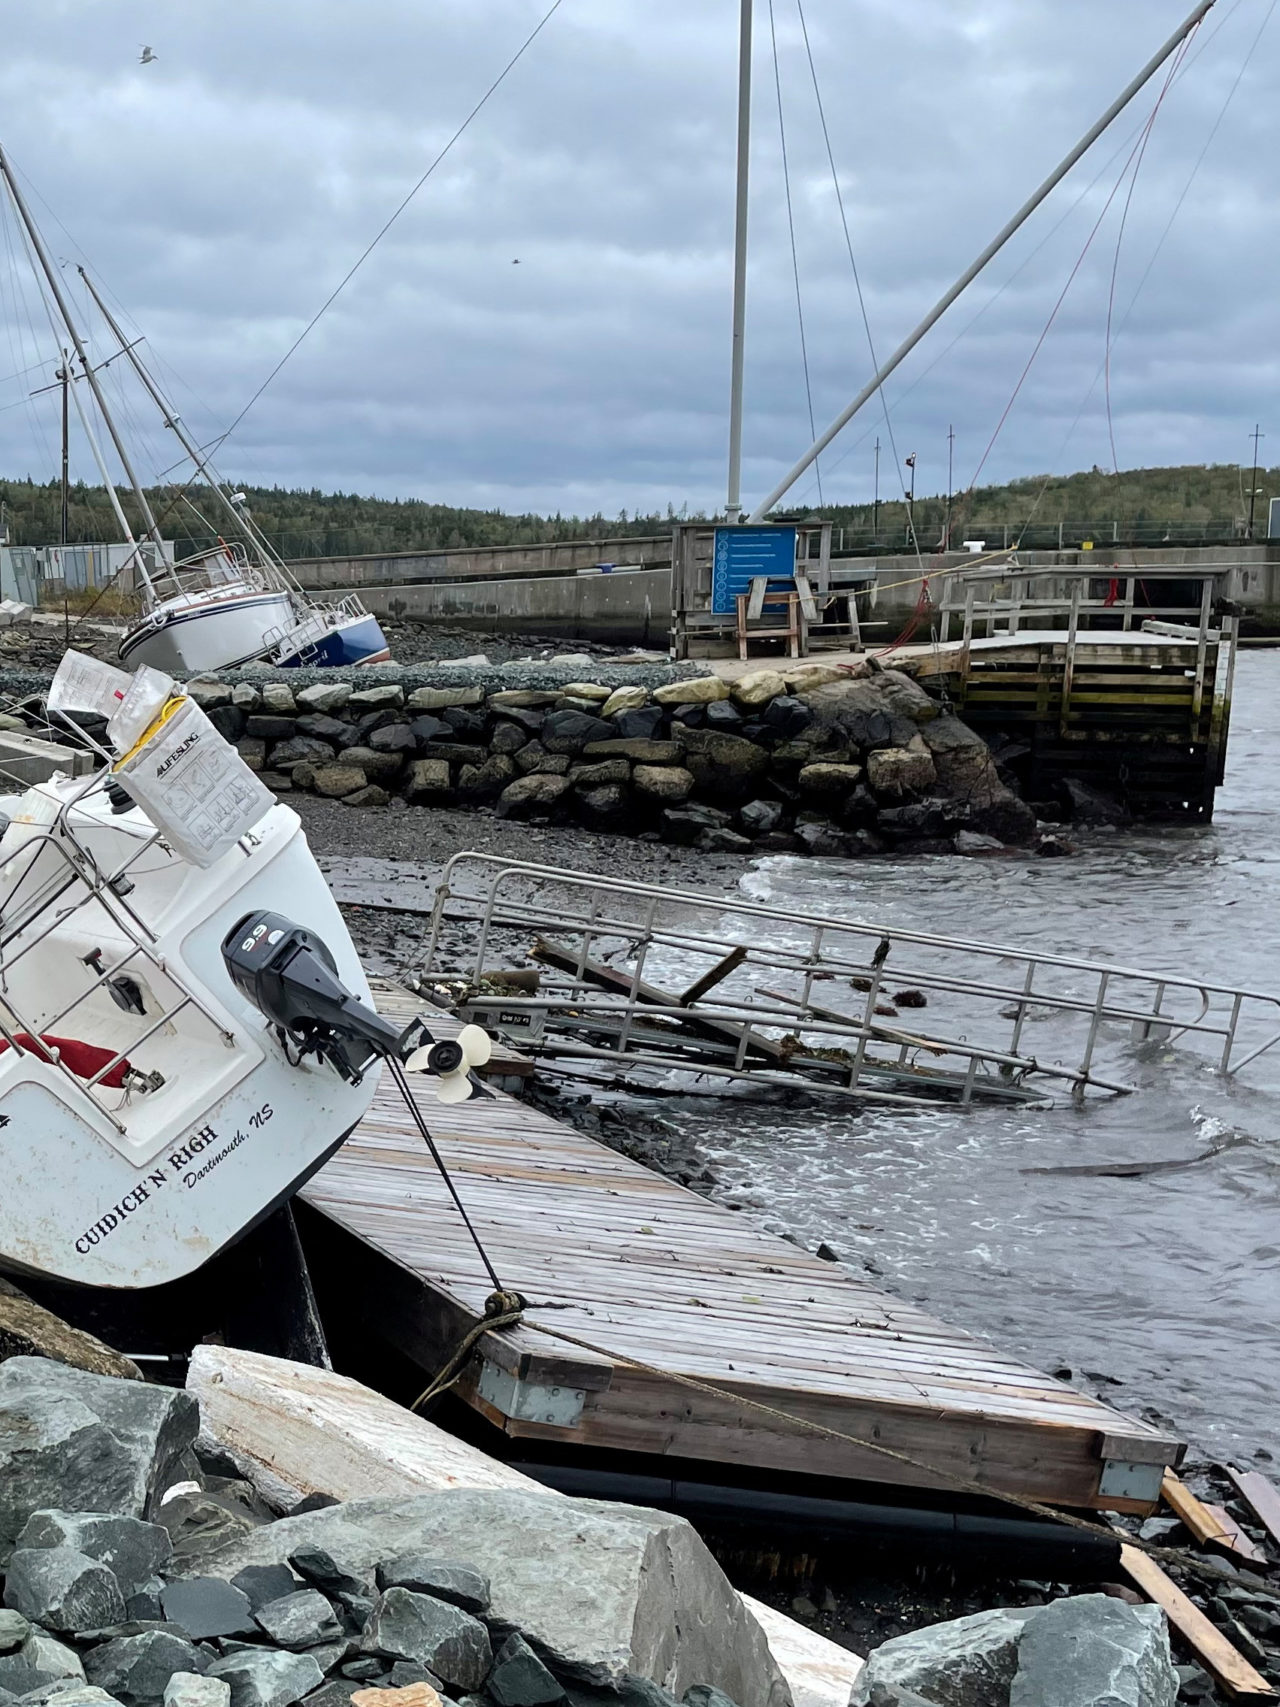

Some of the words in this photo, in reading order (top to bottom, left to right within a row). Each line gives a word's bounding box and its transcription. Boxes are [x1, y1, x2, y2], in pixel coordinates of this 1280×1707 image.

[160, 731, 199, 772] LIFESLING
[241, 924, 267, 952] 9.9
[183, 1129, 249, 1188] Dartmouth,
[249, 1103, 274, 1128] NS
[75, 1168, 168, 1254] CUIDICH'N
[167, 1124, 218, 1171] RIGH
